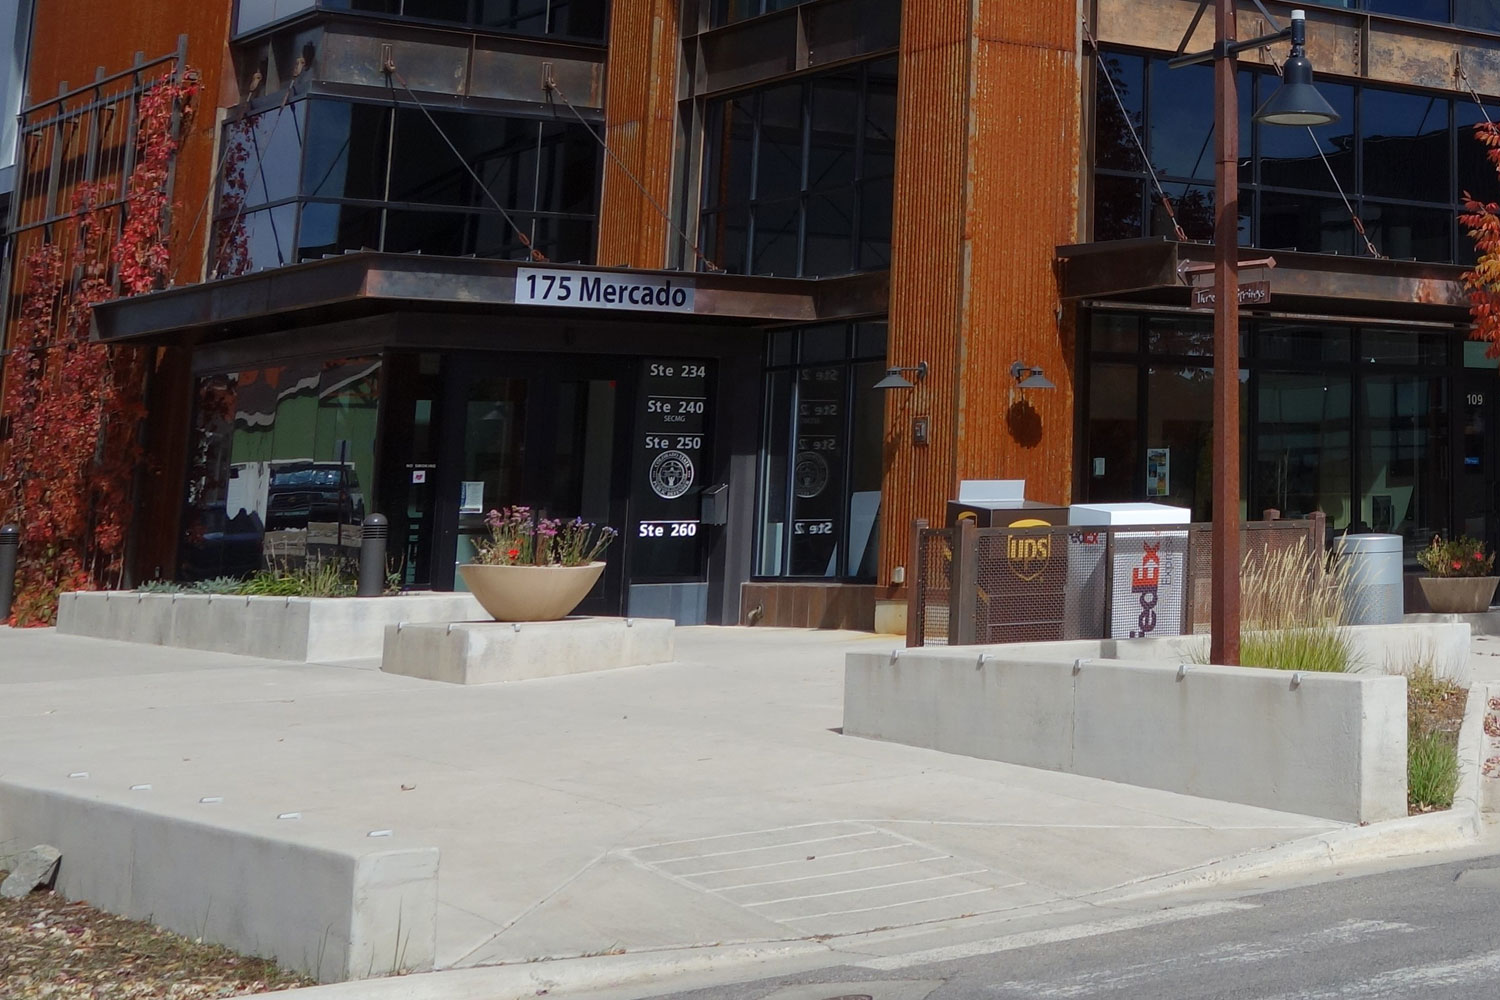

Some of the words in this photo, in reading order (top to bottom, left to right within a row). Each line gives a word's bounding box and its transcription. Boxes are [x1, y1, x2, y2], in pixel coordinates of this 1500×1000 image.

[526, 274, 571, 301] 175
[579, 277, 687, 307] Mercado
[650, 364, 674, 377] Ste
[681, 365, 705, 378] 234
[1466, 394, 1483, 405] 109
[647, 400, 671, 413] Ste
[678, 401, 704, 414] 240
[645, 436, 669, 449] Ste
[676, 437, 701, 449] 250
[639, 524, 664, 537] Ste
[670, 523, 697, 537] 260
[1129, 540, 1161, 638] edEx
